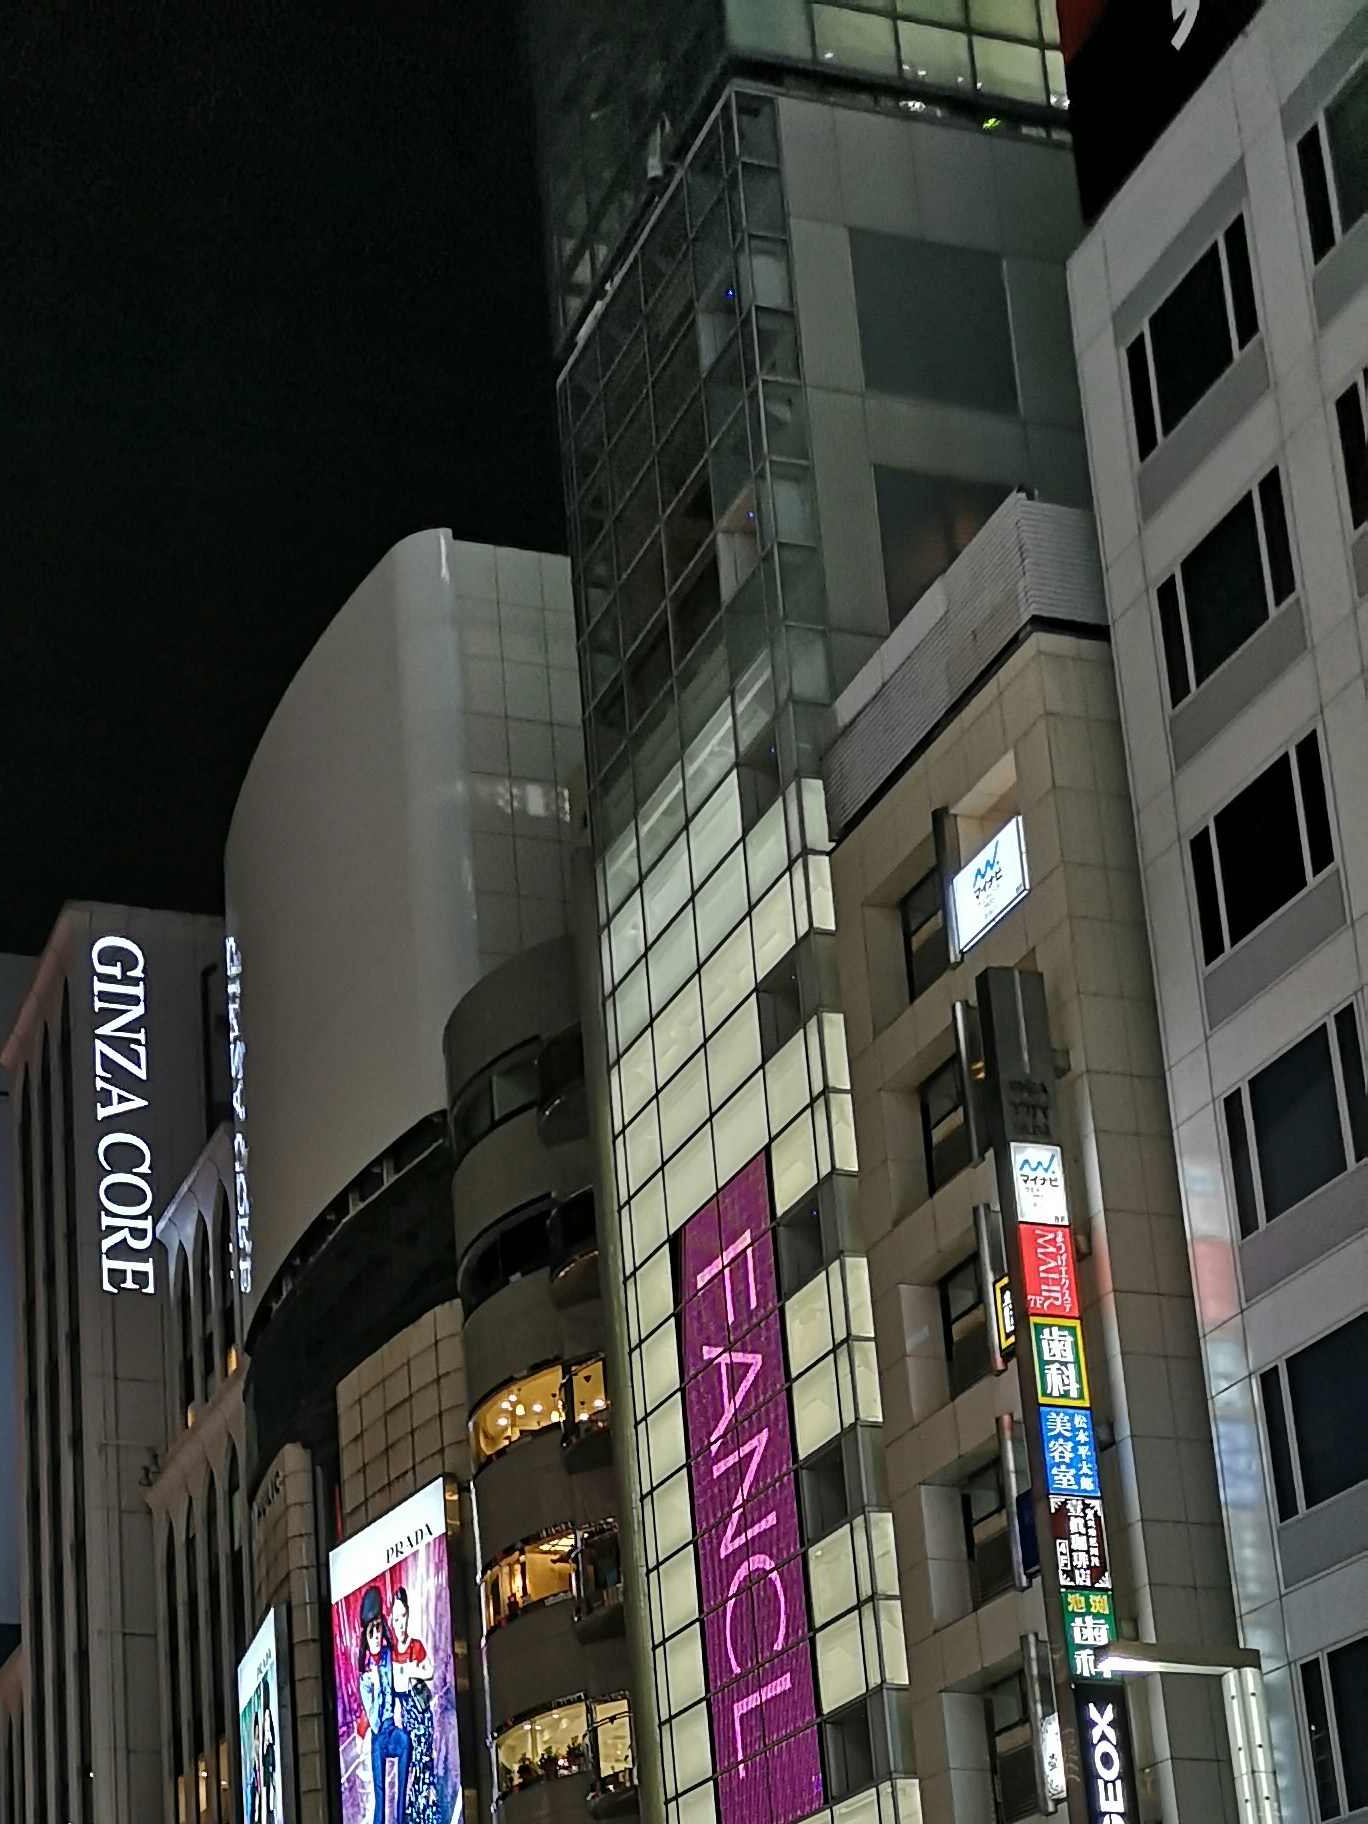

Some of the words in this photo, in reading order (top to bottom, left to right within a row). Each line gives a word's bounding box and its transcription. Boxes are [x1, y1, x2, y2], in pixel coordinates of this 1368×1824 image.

[90, 935, 149, 1121] GINZA
[97, 1132, 157, 1296] CORE
[1020, 1173, 1060, 1188] マイナビ
[1027, 1294, 1044, 1311] 7F
[1055, 1229, 1073, 1313] まつげエクステ
[1039, 1326, 1081, 1399] 歯科
[1045, 1411, 1079, 1491] 美容室
[385, 1522, 434, 1564] PRADA
[696, 1228, 792, 1779] FANCL
